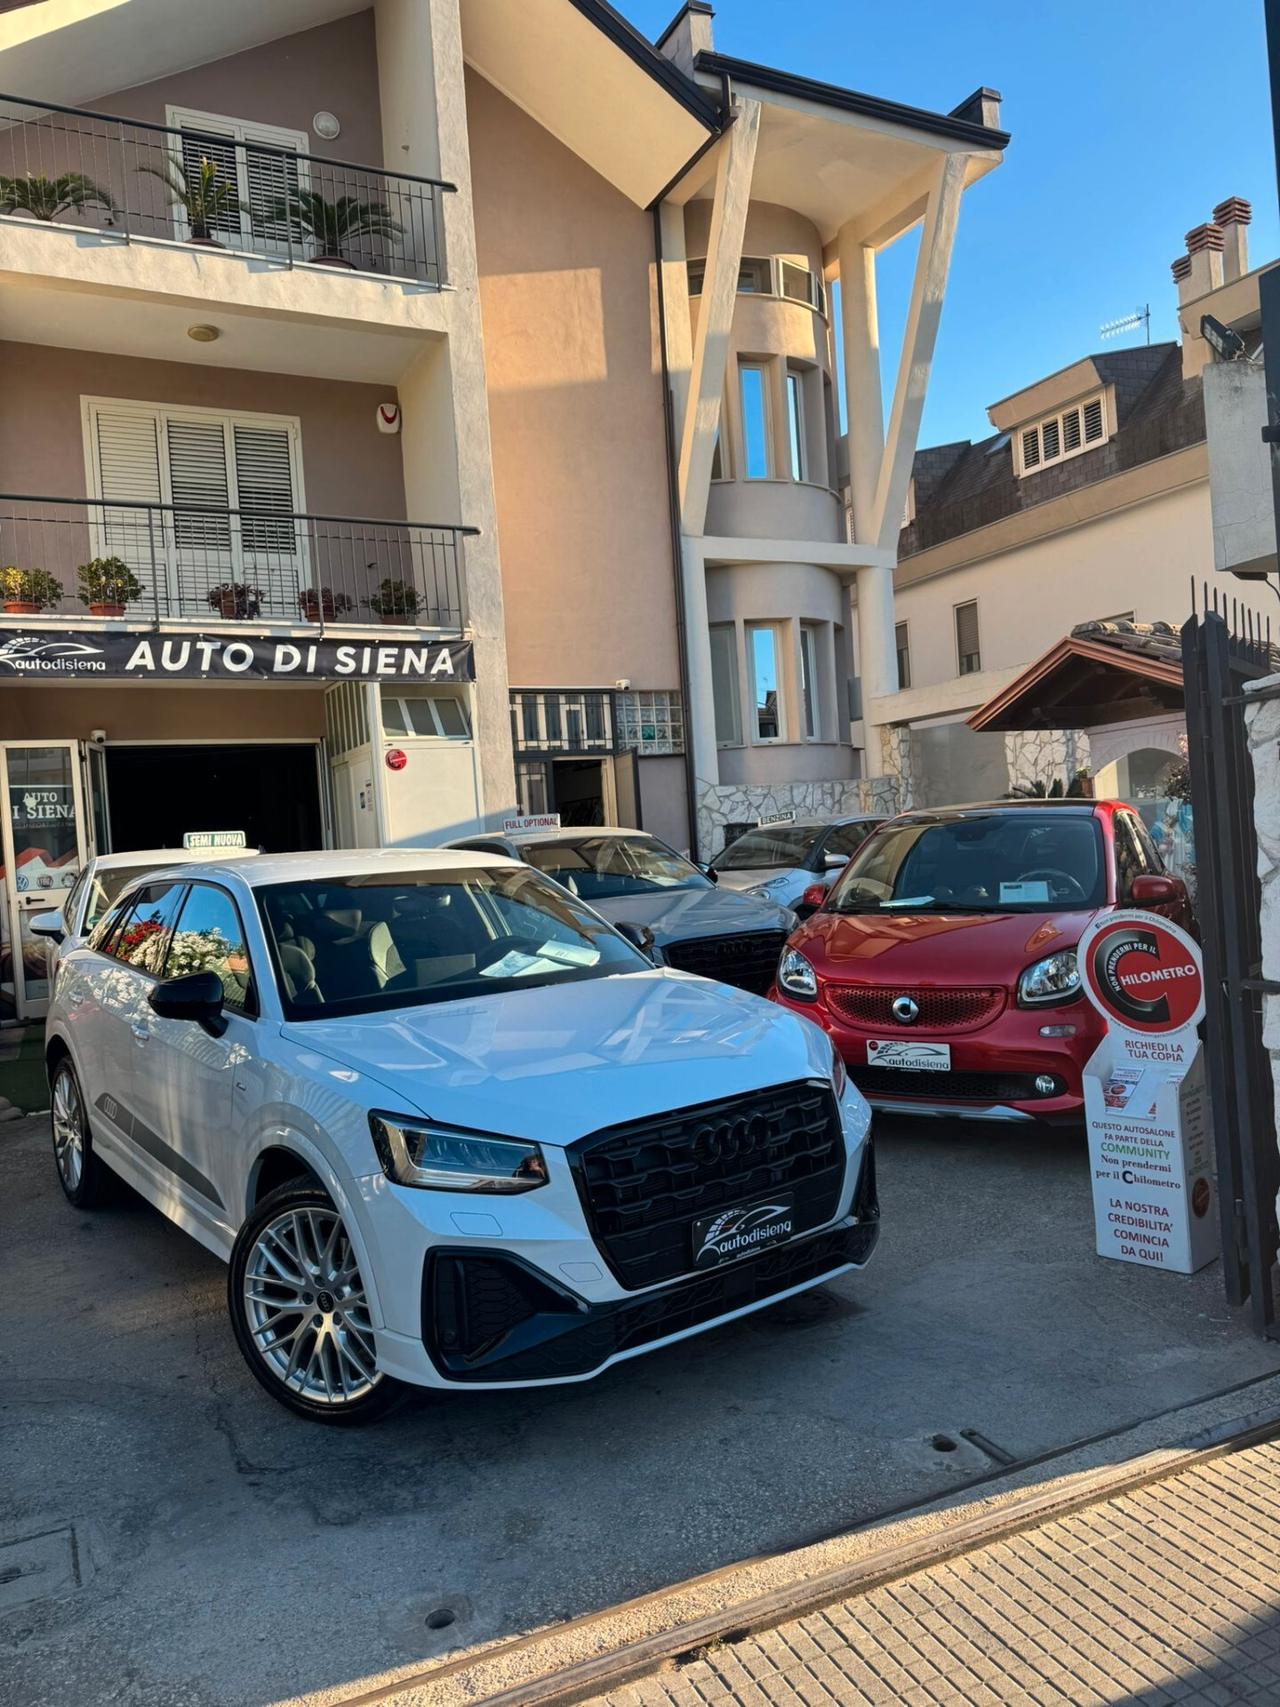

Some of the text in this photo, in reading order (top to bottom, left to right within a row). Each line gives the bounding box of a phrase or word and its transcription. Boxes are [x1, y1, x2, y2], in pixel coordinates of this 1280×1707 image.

[16, 658, 106, 671] autodisiena
[125, 640, 455, 675] AUTO DI SIENA
[22, 792, 58, 802] AUTO
[505, 817, 559, 829] FULL OPTIONAL
[190, 833, 242, 847] SEMI NUOVA
[1108, 943, 1157, 992] NON PRENDERMI PER IL
[1125, 1040, 1184, 1053] RICHIEDI LA
[889, 1058, 949, 1069] autodisiena
[1128, 1049, 1184, 1062] TUA COPIA
[1092, 1120, 1176, 1138] QUESTO AUTOSALONE
[1104, 1133, 1164, 1147] FA PARTE DELLA
[1101, 1142, 1170, 1160] COMMUNITY
[1101, 1154, 1171, 1173] Non prendermi
[1096, 1170, 1181, 1189] per il Chilometro
[1110, 1198, 1169, 1217] LA NOSTRA
[720, 1220, 792, 1253] autodisiena
[1114, 1228, 1170, 1248] COMINCIA
[1121, 1245, 1163, 1262] DA QUI!
